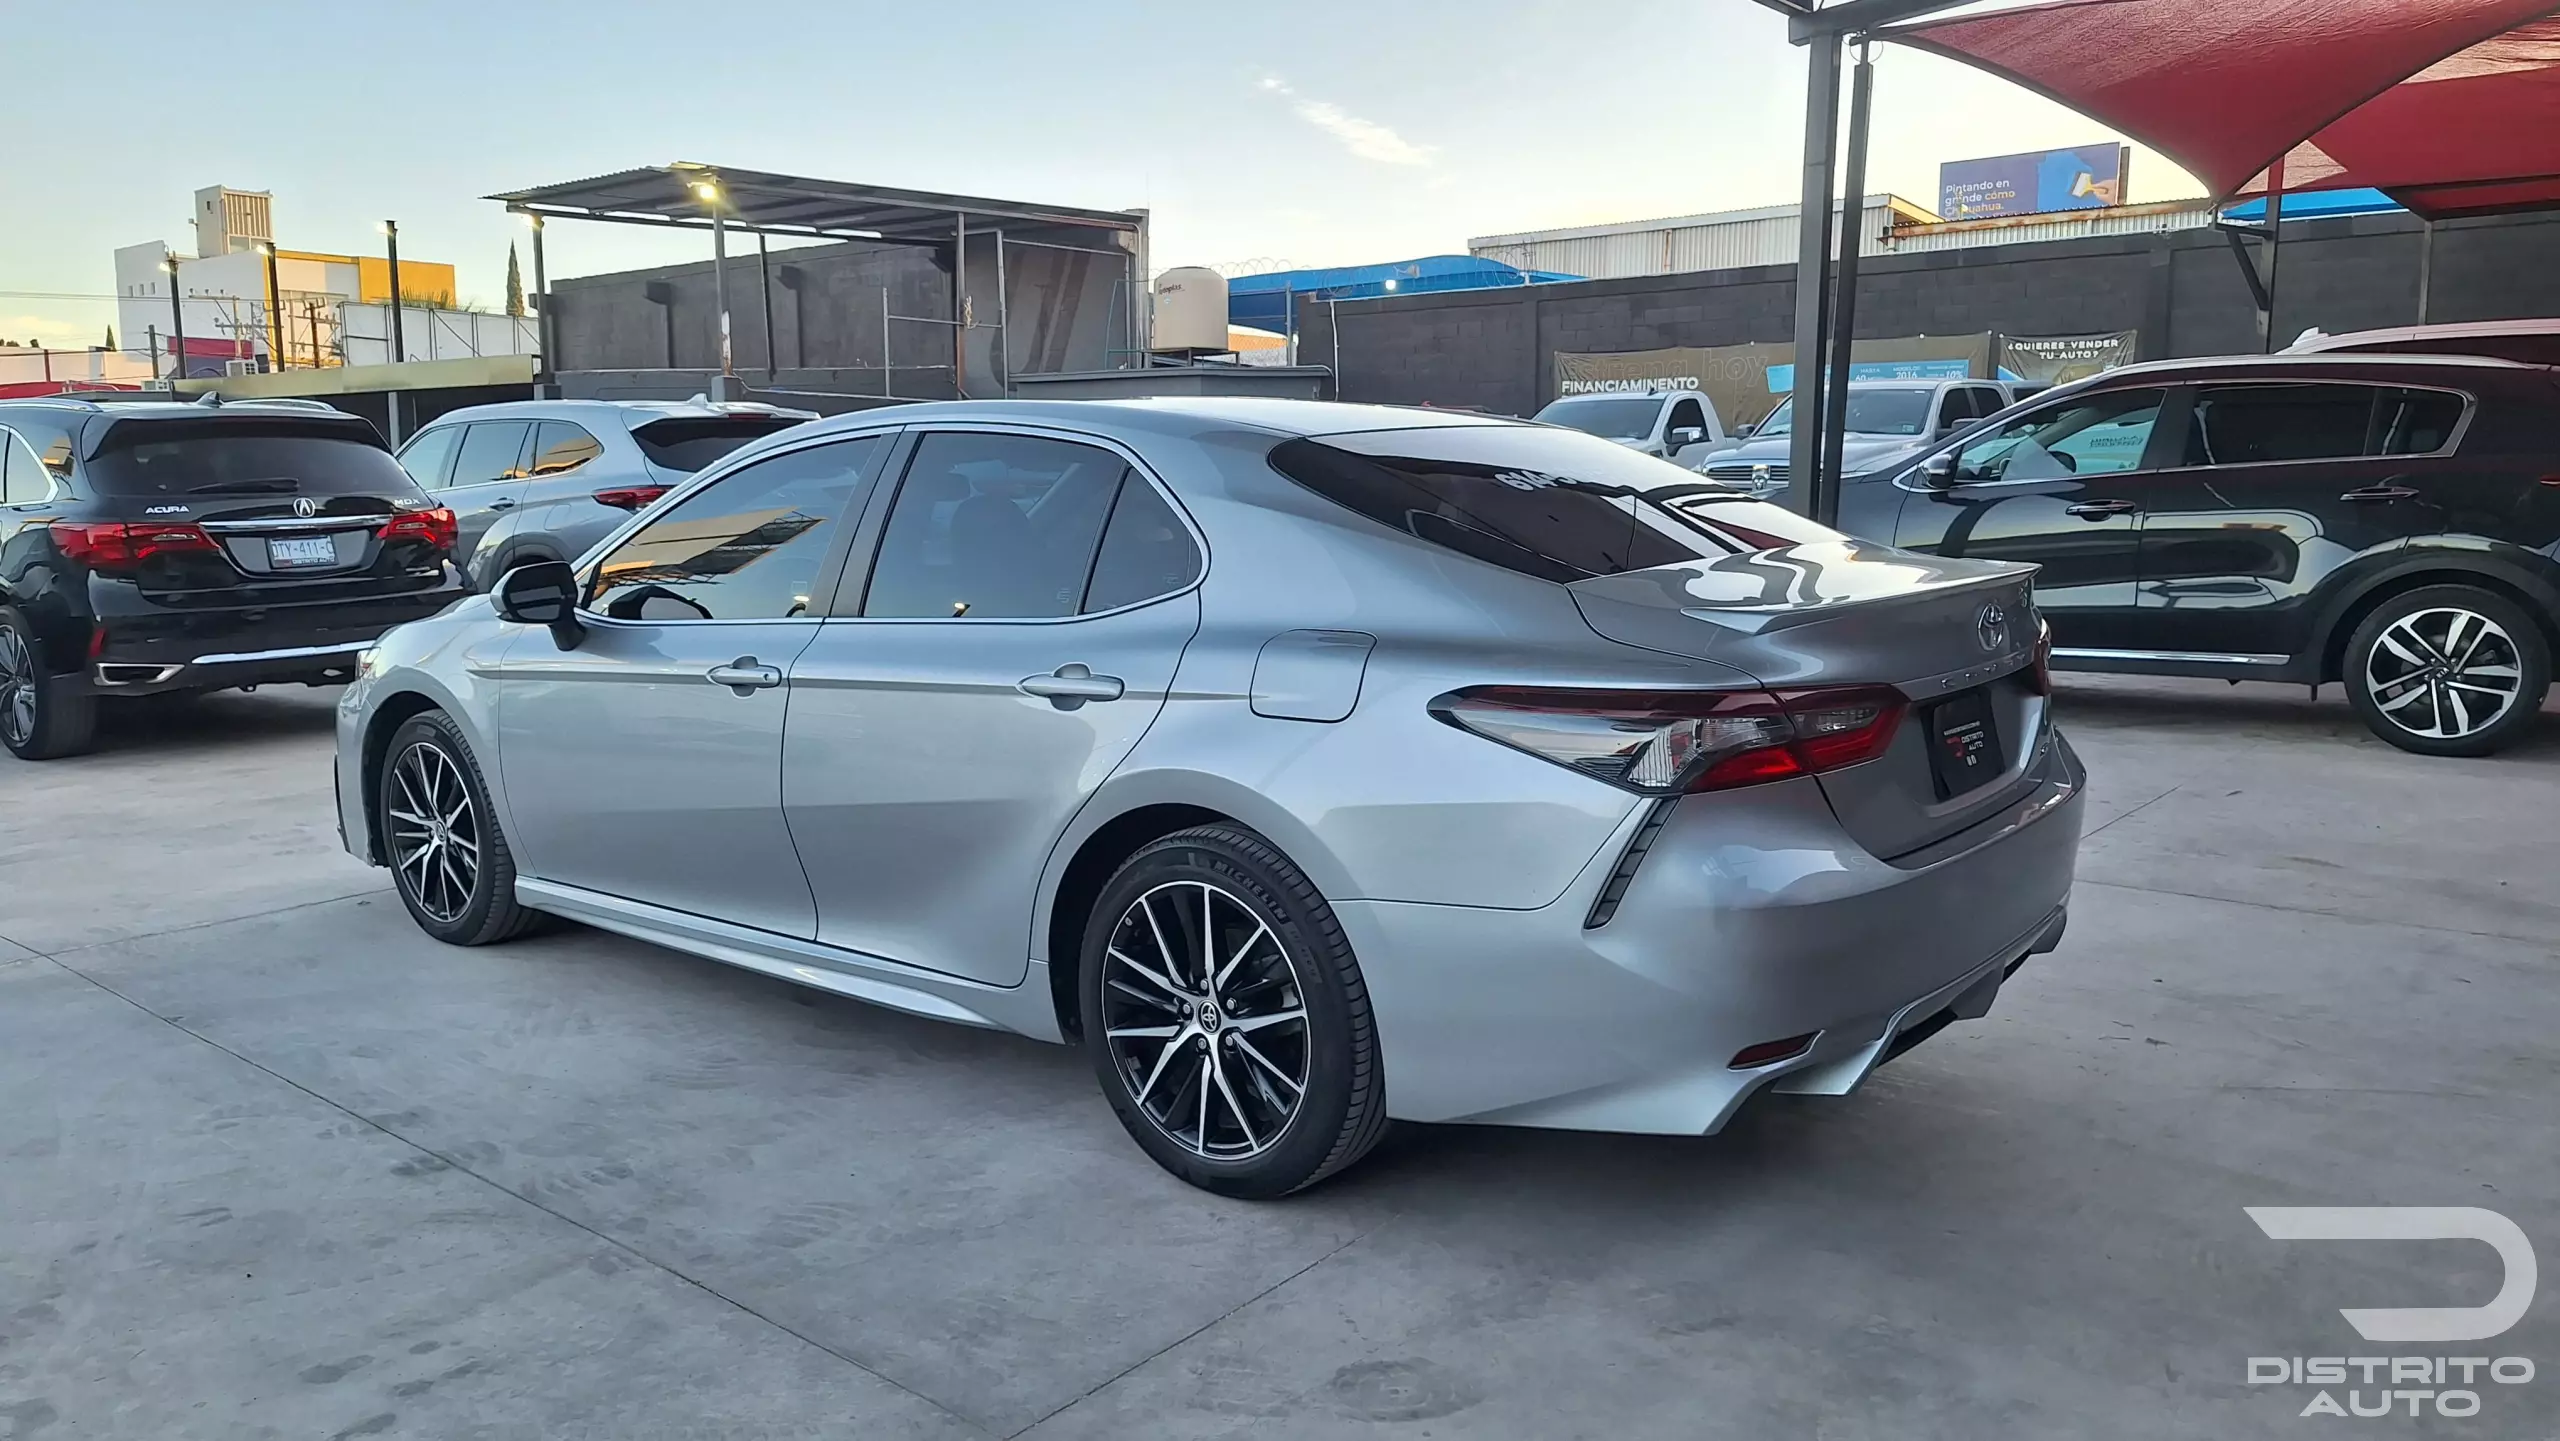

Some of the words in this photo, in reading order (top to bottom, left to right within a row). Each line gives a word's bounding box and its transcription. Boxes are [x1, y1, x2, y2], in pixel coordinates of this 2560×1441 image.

[1945, 181, 1994, 194] Pintando
[1995, 180, 2010, 188] en
[1944, 192, 1983, 207] grnde
[2007, 340, 2066, 351] ¿QUIERES
[2070, 339, 2119, 349] VENDER
[2039, 351, 2055, 360] TU
[2059, 350, 2099, 360] AUTO?
[1703, 348, 1769, 387] hoy
[1895, 371, 1918, 380] 2016
[1946, 369, 1965, 380] 10%
[1561, 376, 1699, 393] FINANCIAMINENTO
[394, 498, 420, 506] MDX
[145, 505, 190, 514] ACURA
[1968, 740, 1984, 751] AUTO
[1213, 860, 1289, 923] MICHELIN
